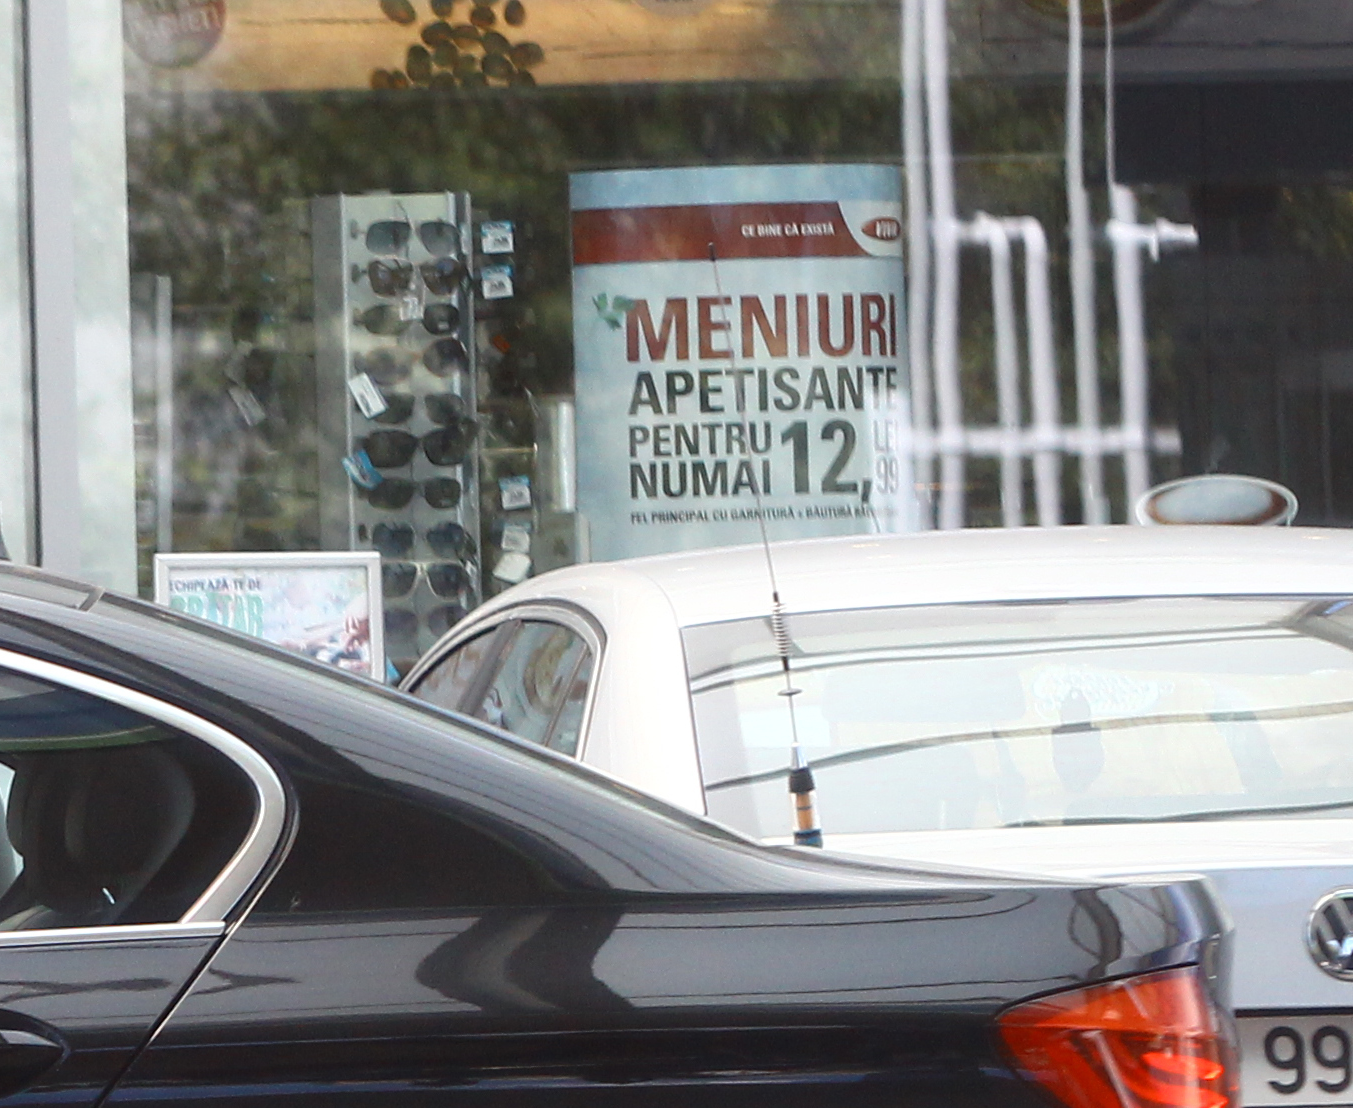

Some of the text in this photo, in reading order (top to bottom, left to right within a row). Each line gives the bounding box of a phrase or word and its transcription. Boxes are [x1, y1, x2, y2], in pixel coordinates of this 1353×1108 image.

[626, 293, 897, 361] MENIURI
[628, 366, 897, 415] APETISANTE
[629, 422, 771, 457] PENTRU
[630, 460, 771, 499] NUMAI
[651, 508, 708, 523] PRINCIPAL
[713, 507, 728, 520] CU
[1263, 1025, 1352, 1094] 99
